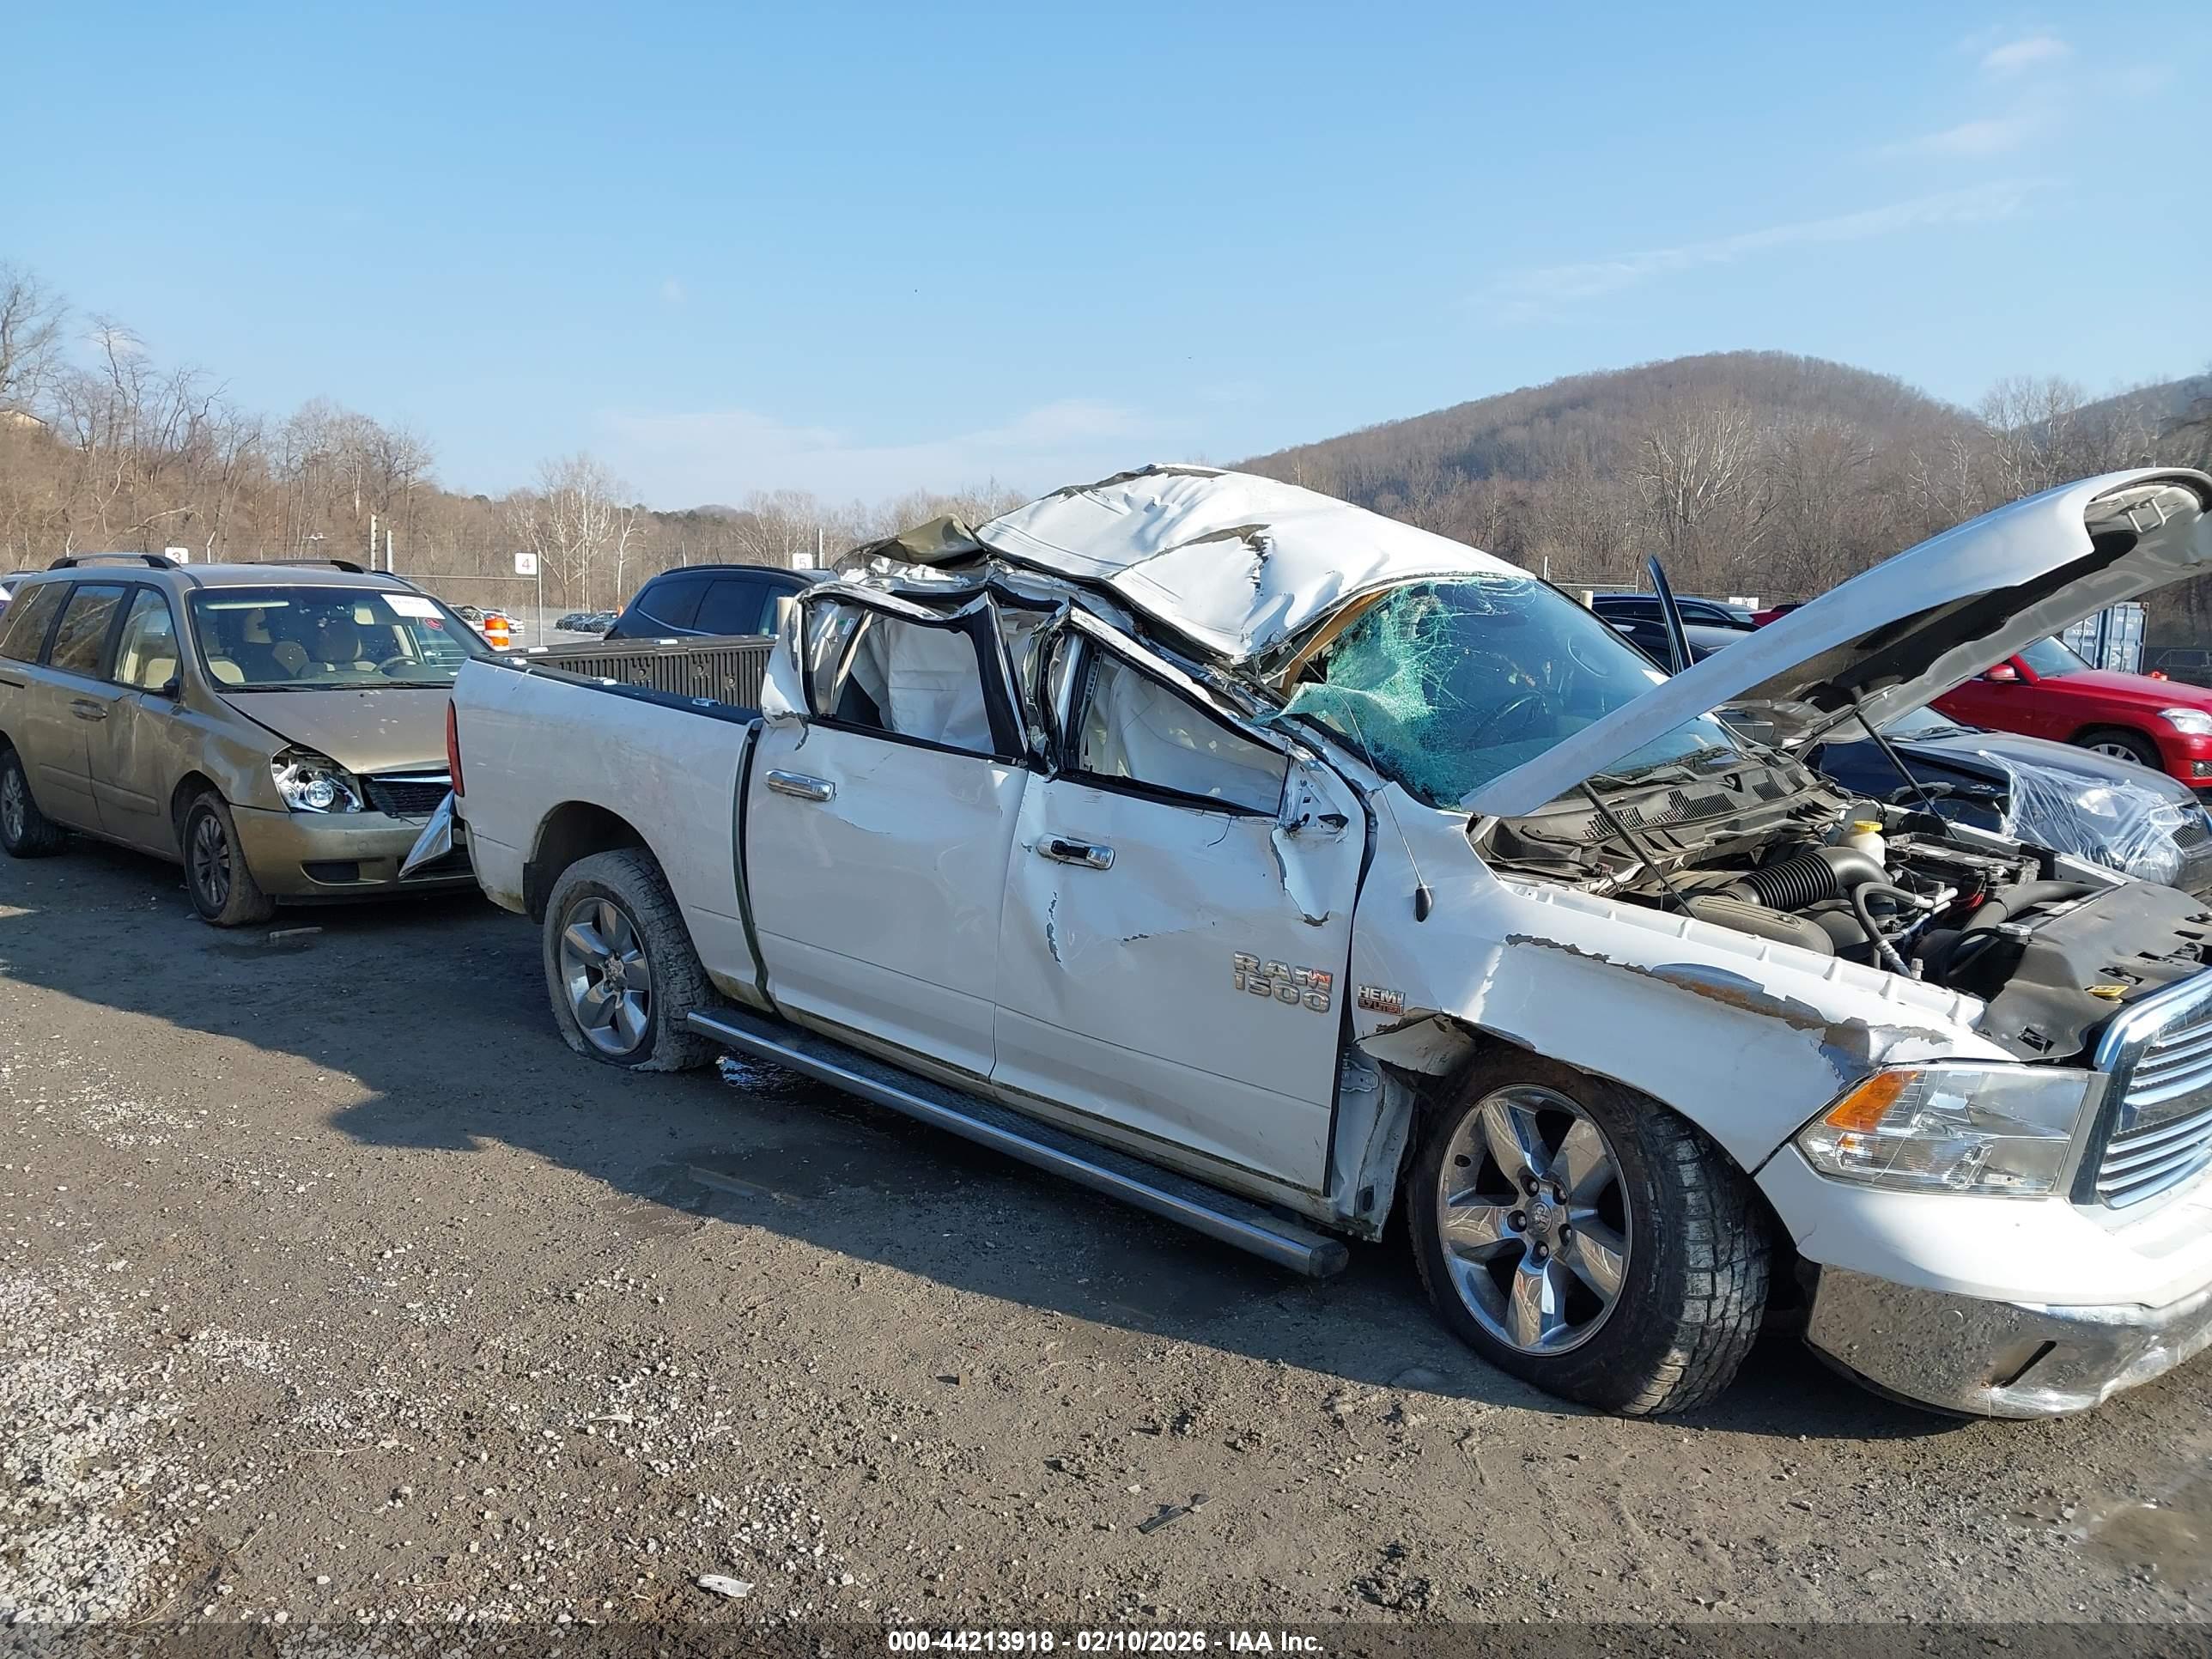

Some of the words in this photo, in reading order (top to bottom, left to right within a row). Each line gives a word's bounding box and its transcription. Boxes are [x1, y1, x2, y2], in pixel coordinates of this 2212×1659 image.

[172, 552, 182, 563] 3
[521, 558, 532, 570] 4
[799, 558, 806, 569] 5
[1234, 951, 1333, 993] RAM
[1234, 971, 1330, 1013] 1500
[1358, 985, 1405, 1005] HEMI
